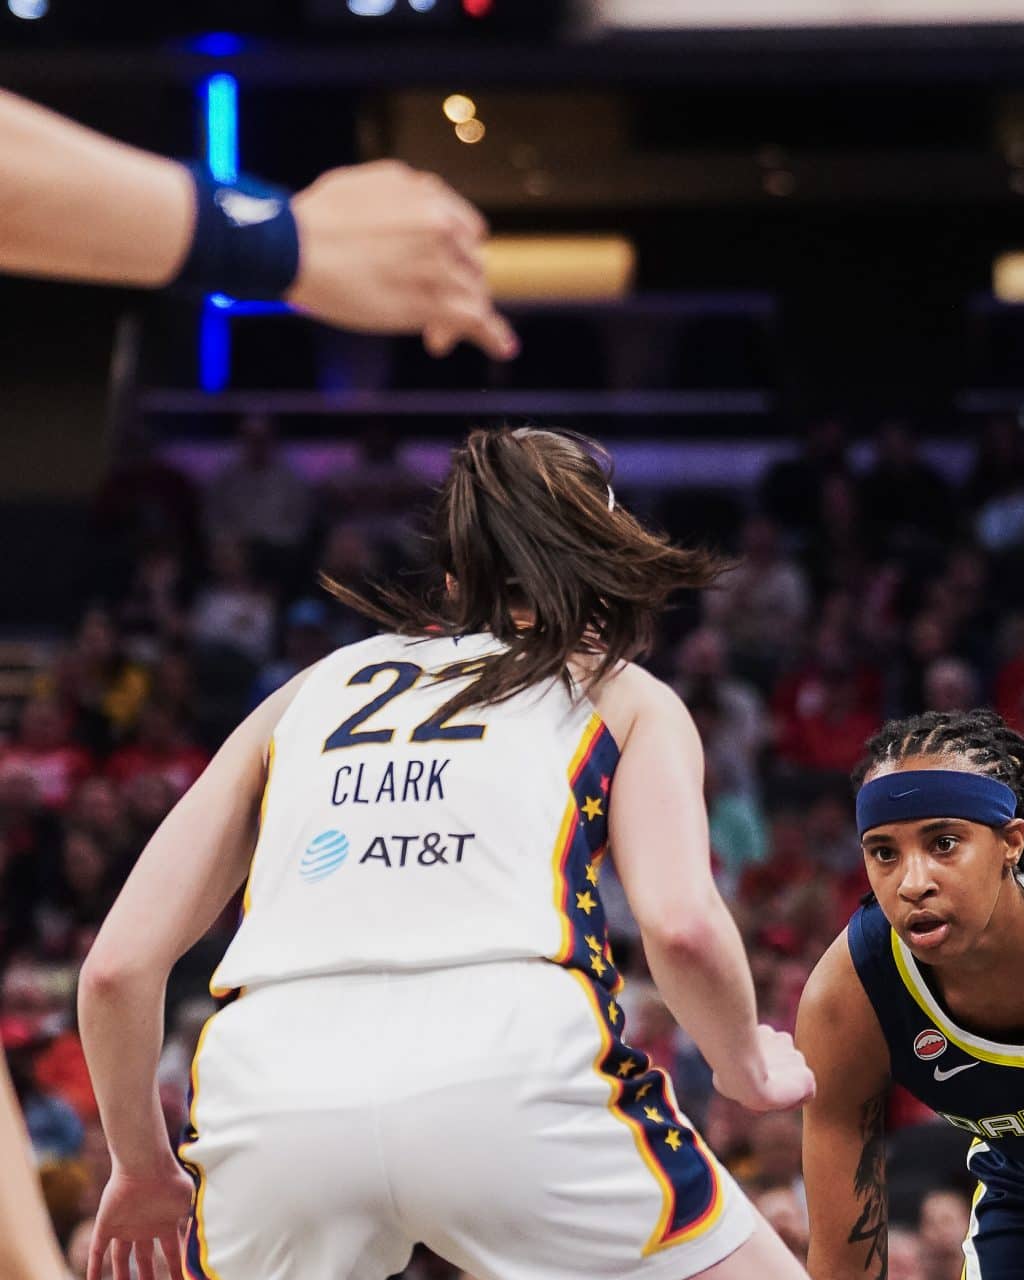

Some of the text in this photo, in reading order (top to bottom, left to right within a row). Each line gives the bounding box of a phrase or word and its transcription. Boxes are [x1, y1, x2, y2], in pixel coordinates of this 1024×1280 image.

[321, 654, 489, 755] 22
[331, 759, 451, 806] CLARK
[358, 832, 476, 868] AT&T
